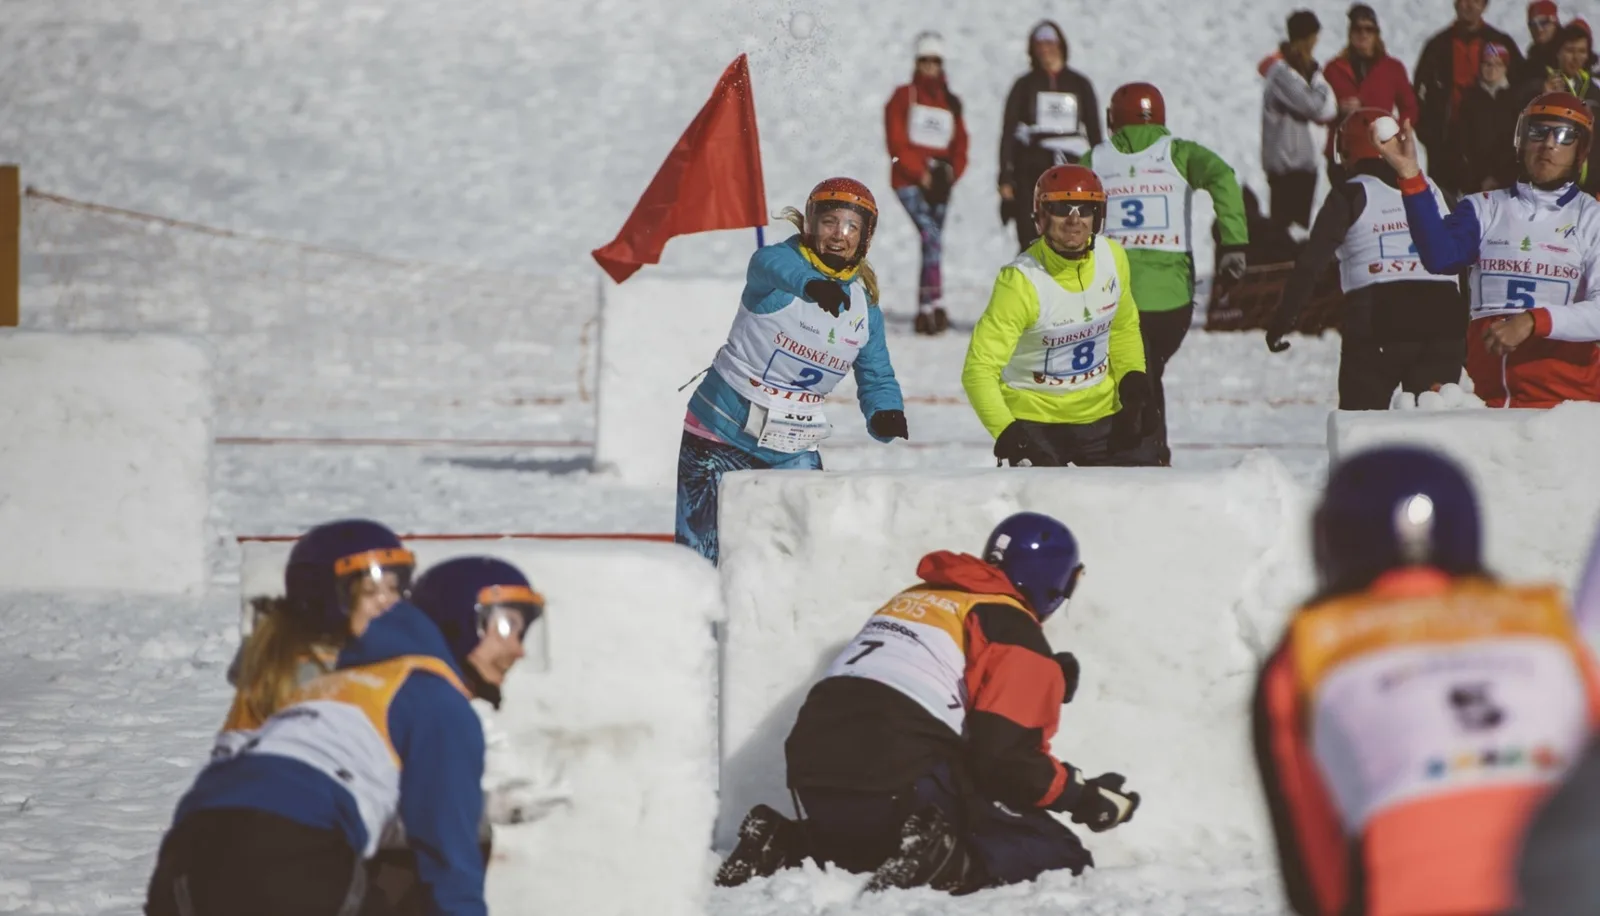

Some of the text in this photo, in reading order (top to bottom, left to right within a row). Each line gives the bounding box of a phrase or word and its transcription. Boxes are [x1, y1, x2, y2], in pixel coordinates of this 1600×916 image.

[1120, 199, 1145, 228] 3
[1536, 262, 1579, 280] PLESO
[1504, 279, 1537, 309] 5
[773, 330, 829, 364] ŠTRBSKÉ
[1041, 325, 1096, 347] ŠTRBSKÉ
[1071, 340, 1096, 371] 8
[789, 367, 824, 391] 2
[844, 640, 885, 665] 7
